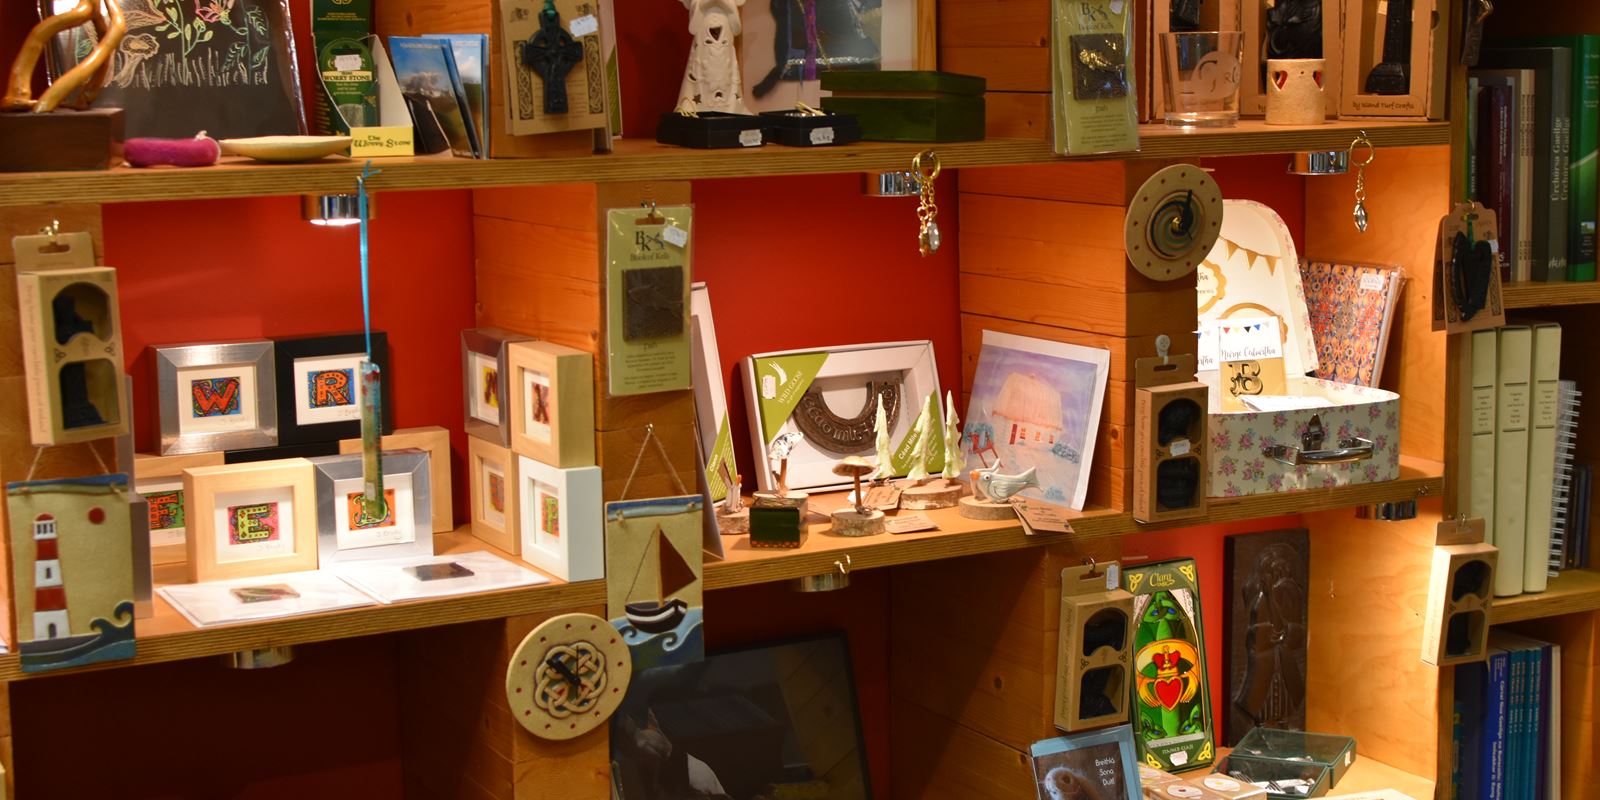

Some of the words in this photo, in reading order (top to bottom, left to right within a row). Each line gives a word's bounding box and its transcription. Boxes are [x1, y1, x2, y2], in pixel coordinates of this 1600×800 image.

[192, 380, 239, 416] W
[316, 370, 349, 407] R
[237, 506, 270, 541] E
